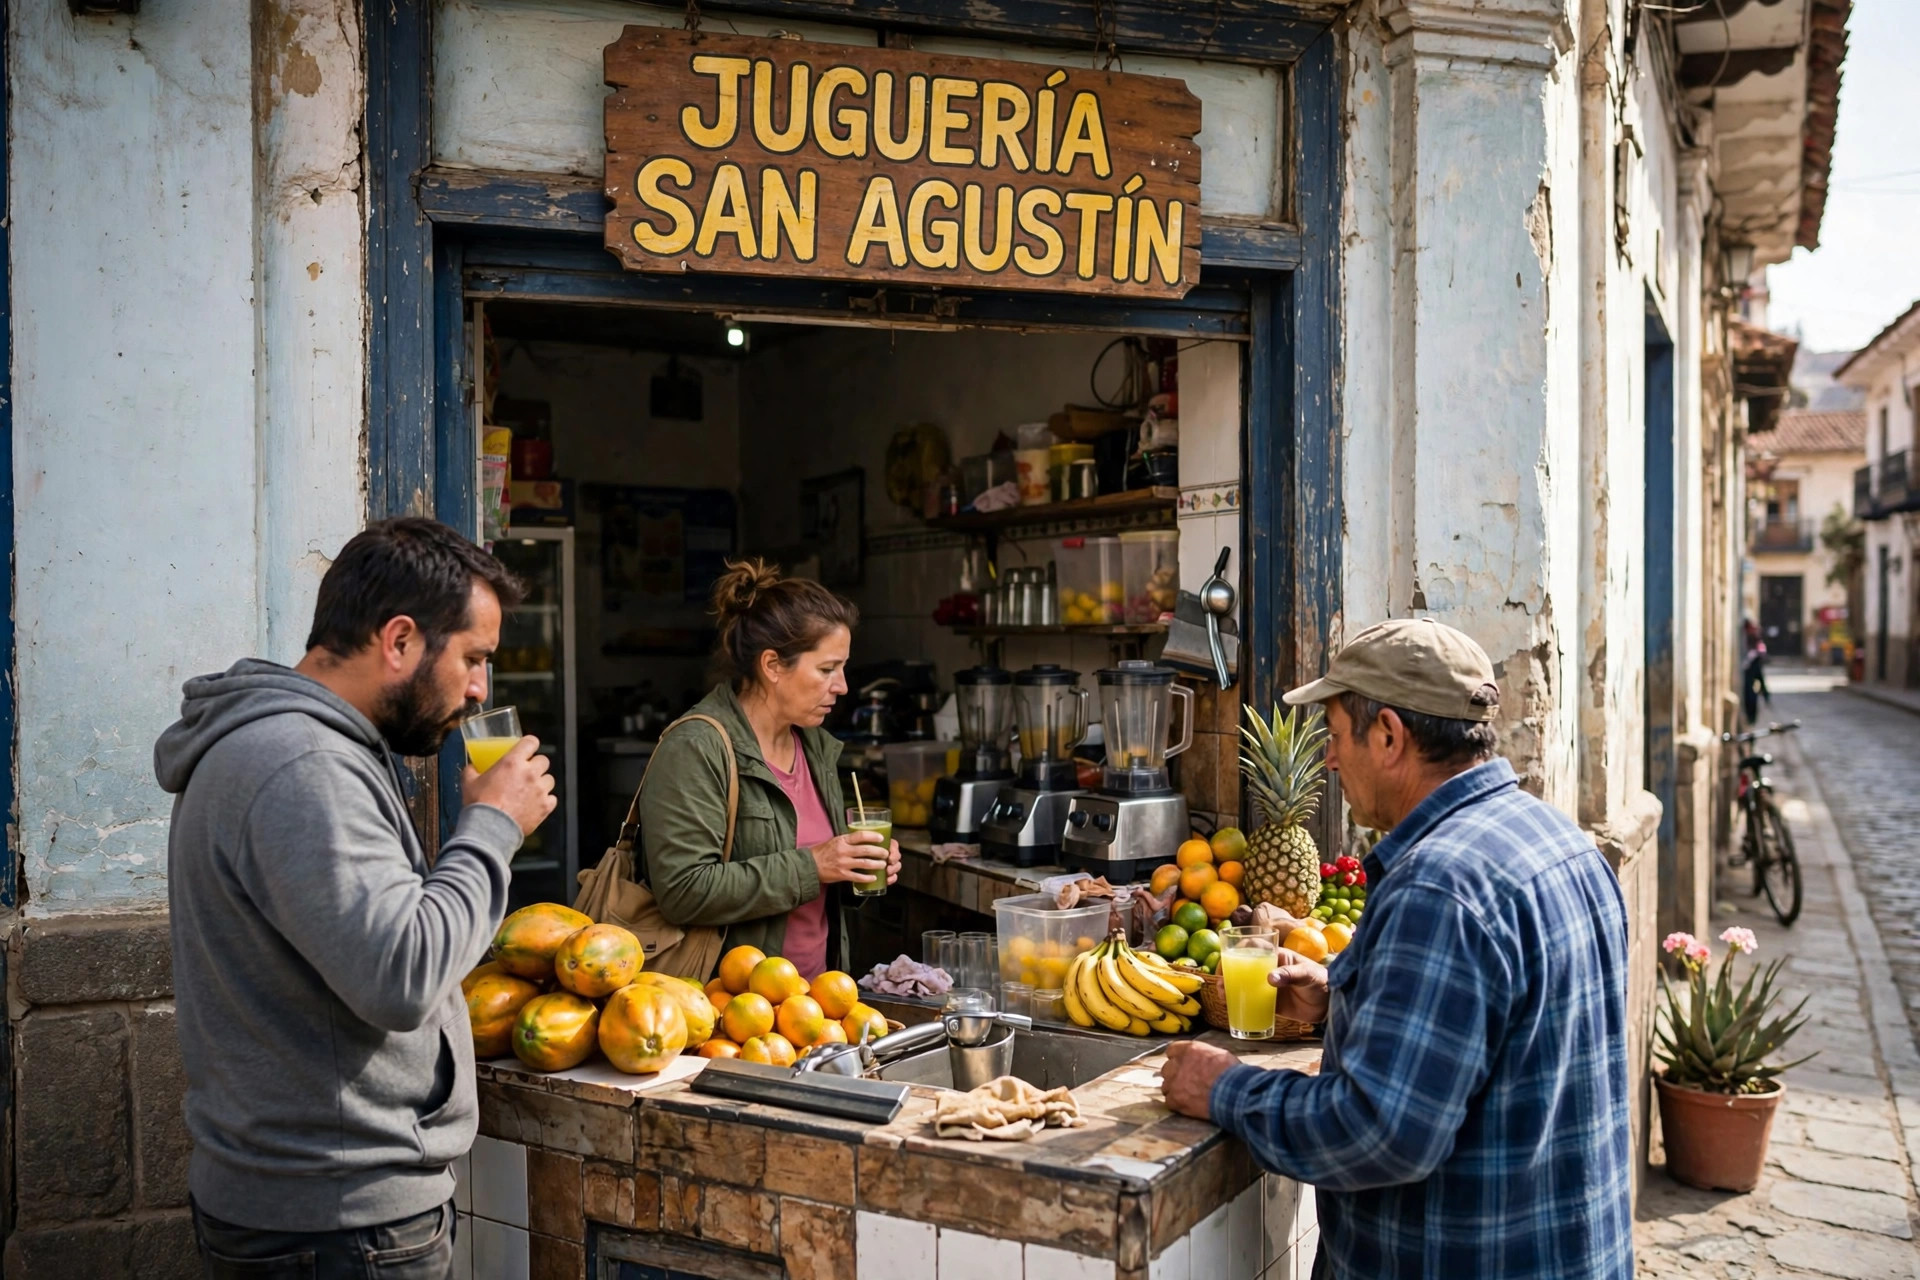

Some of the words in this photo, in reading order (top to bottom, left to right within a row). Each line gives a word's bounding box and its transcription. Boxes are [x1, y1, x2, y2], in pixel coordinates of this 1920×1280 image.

[682, 56, 1111, 178] JUGUERÍA
[633, 157, 817, 261] SAN
[847, 175, 1183, 285] AGUSTÍN
